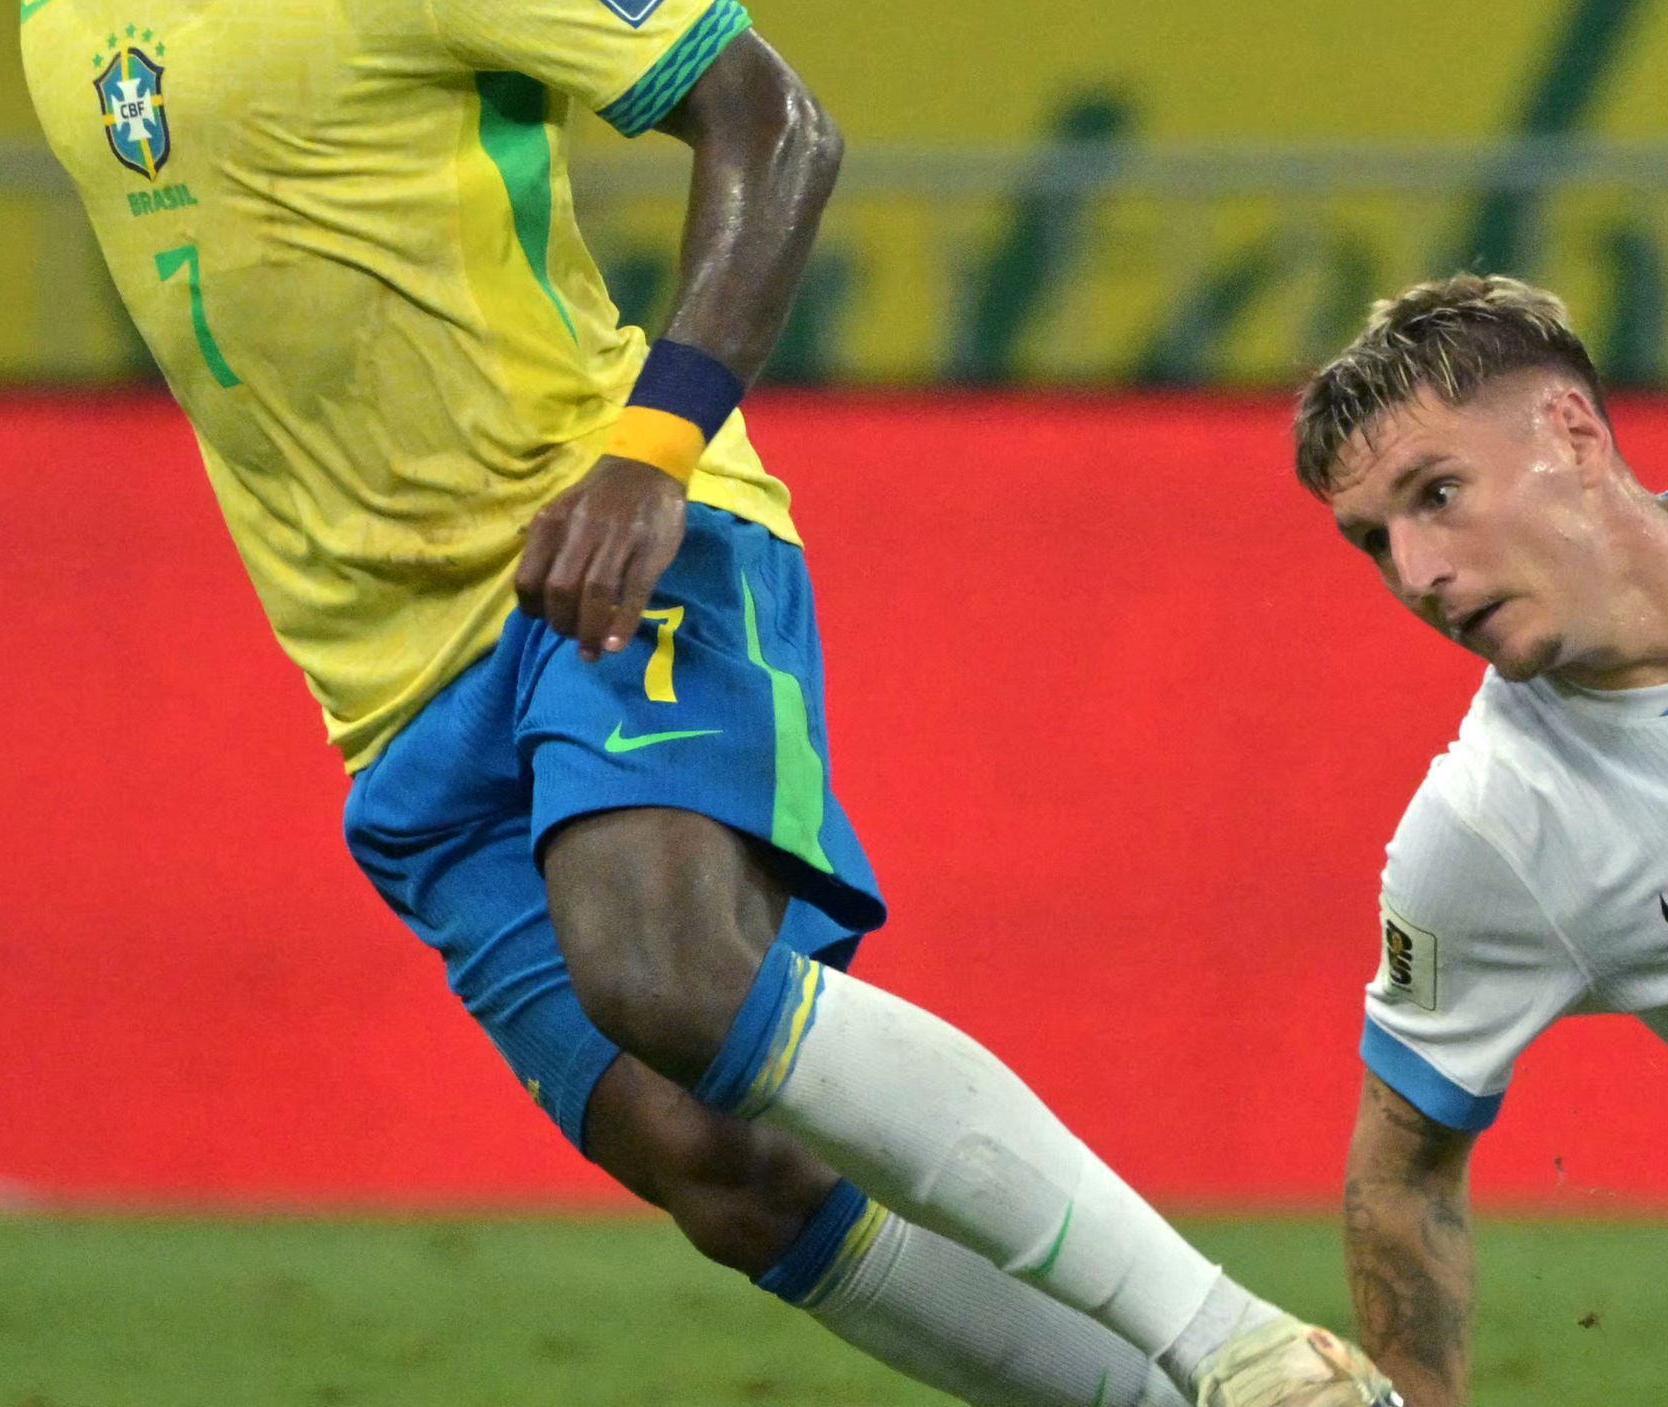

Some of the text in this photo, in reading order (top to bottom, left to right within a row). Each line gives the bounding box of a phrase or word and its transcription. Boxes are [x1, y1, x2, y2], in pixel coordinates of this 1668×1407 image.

[120, 101, 144, 119] CBF
[127, 183, 199, 217] BRASIL
[155, 244, 243, 389] 7
[640, 605, 685, 703] 7
